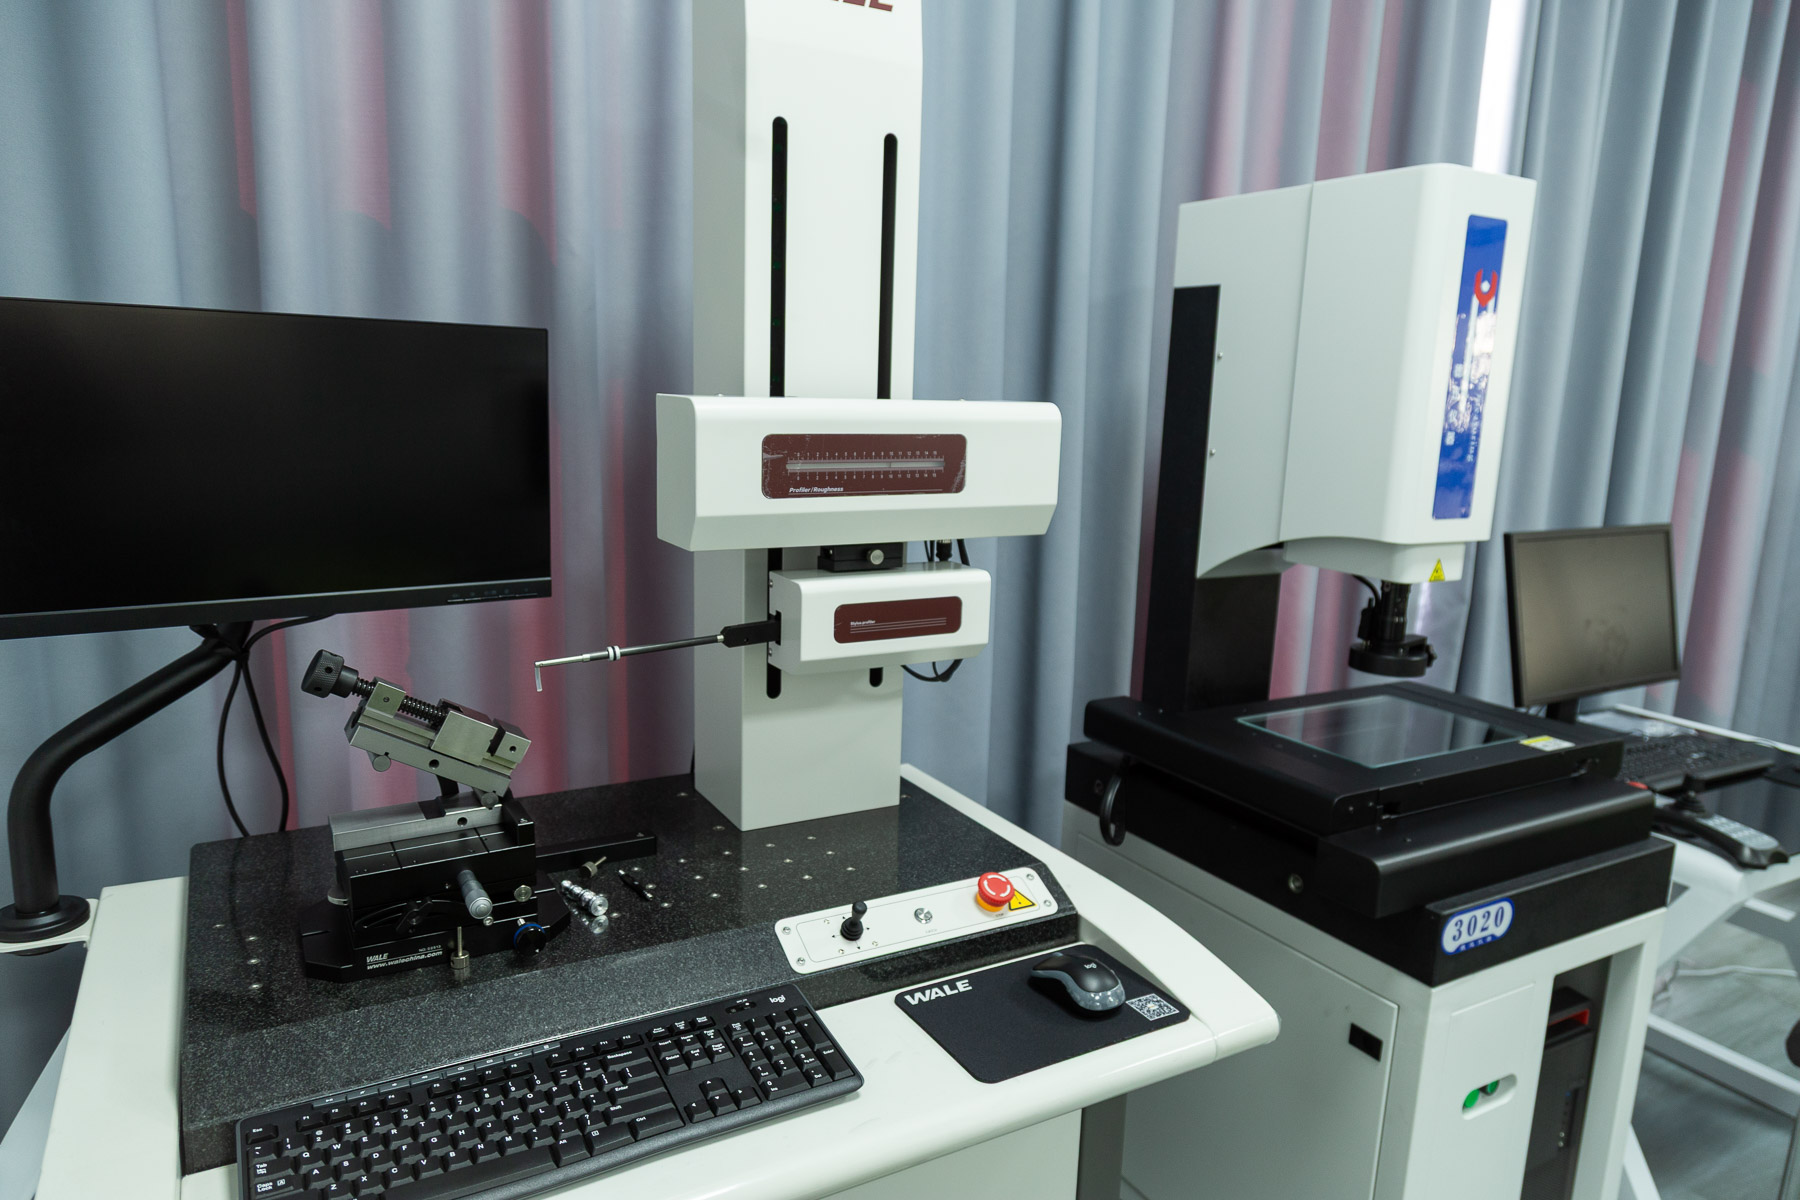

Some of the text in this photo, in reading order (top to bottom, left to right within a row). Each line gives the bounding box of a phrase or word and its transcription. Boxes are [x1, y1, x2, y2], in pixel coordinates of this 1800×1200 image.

[1452, 906, 1504, 942] 3020
[366, 953, 389, 963] WALE
[904, 979, 972, 1005] WALE
